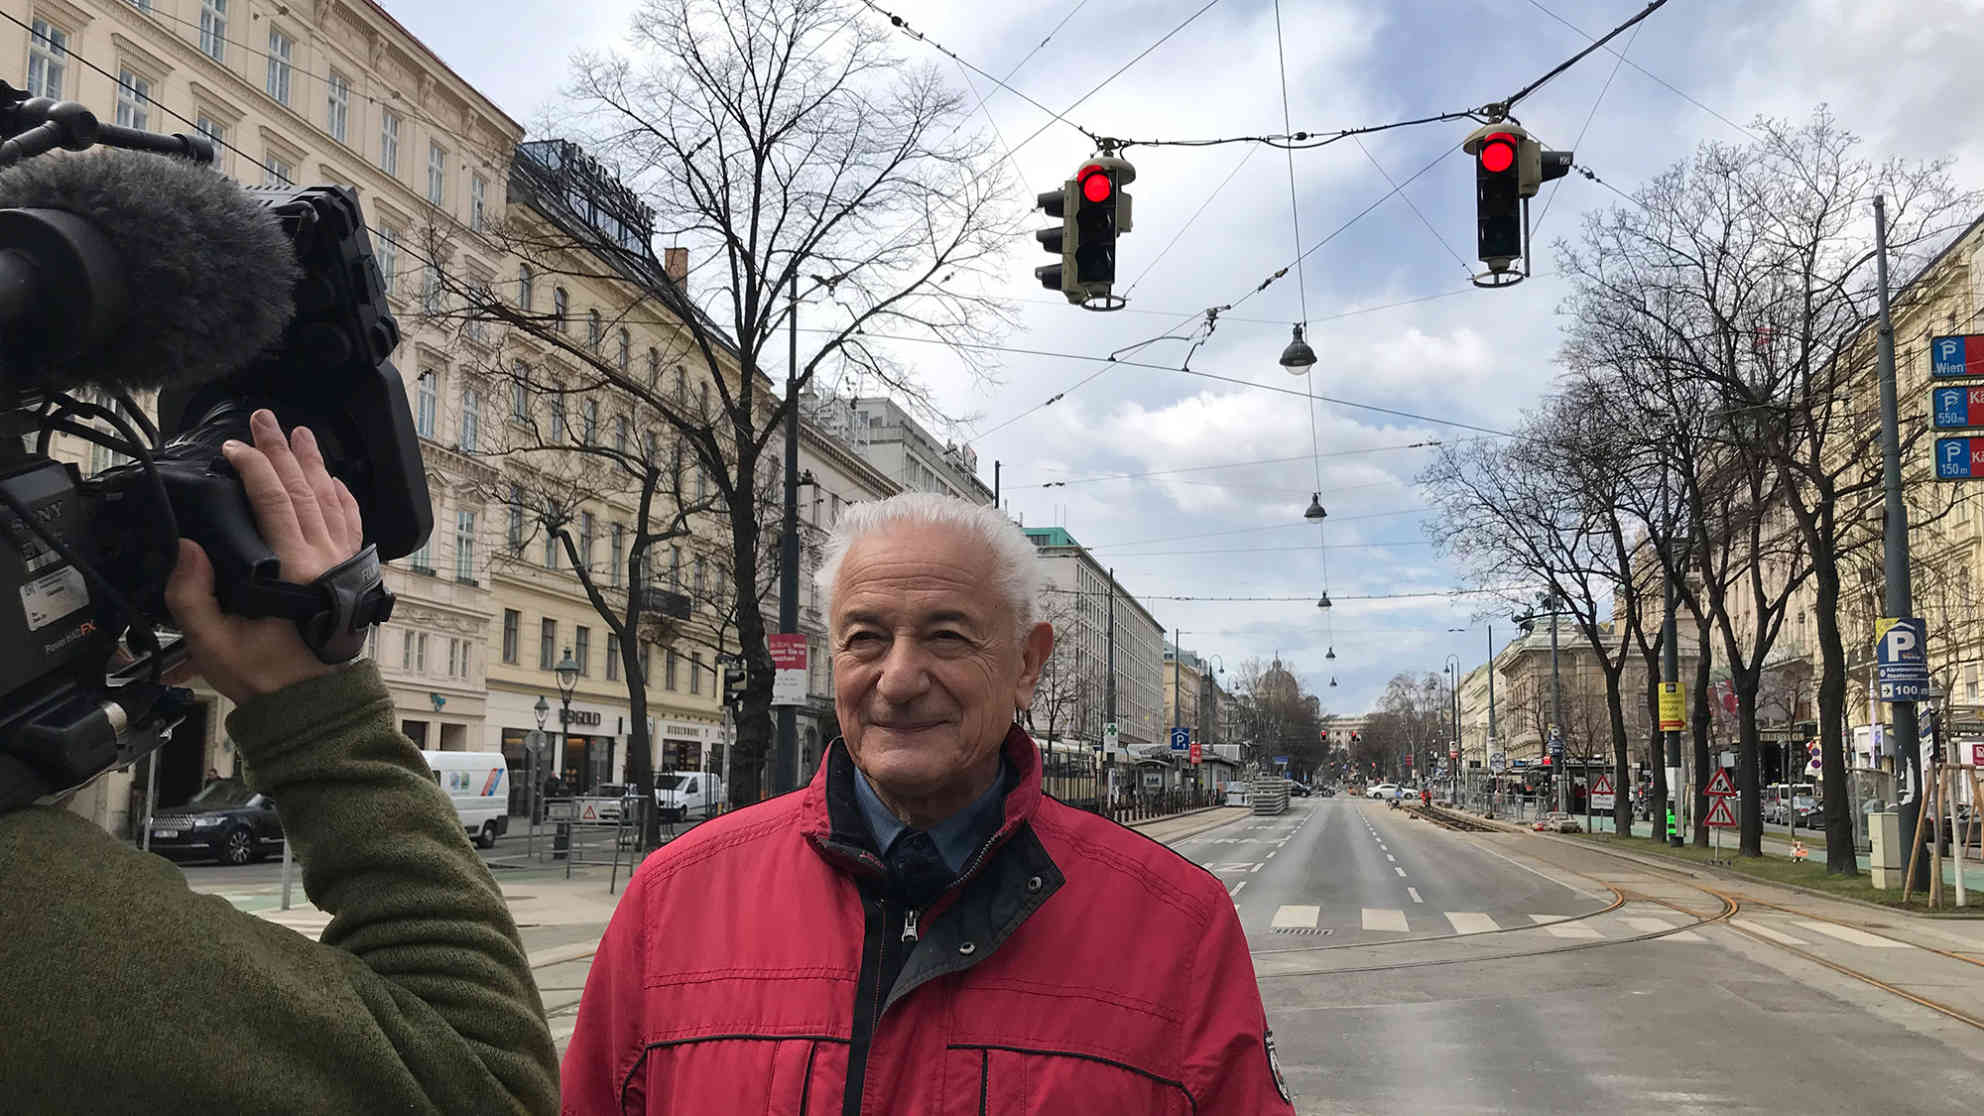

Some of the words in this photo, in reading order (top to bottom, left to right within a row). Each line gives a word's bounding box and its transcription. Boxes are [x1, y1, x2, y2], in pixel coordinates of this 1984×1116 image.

[1936, 362, 1964, 374] Wien
[1947, 447, 1961, 462] P
[1888, 631, 1916, 662] P
[1895, 685, 1918, 696] 100
